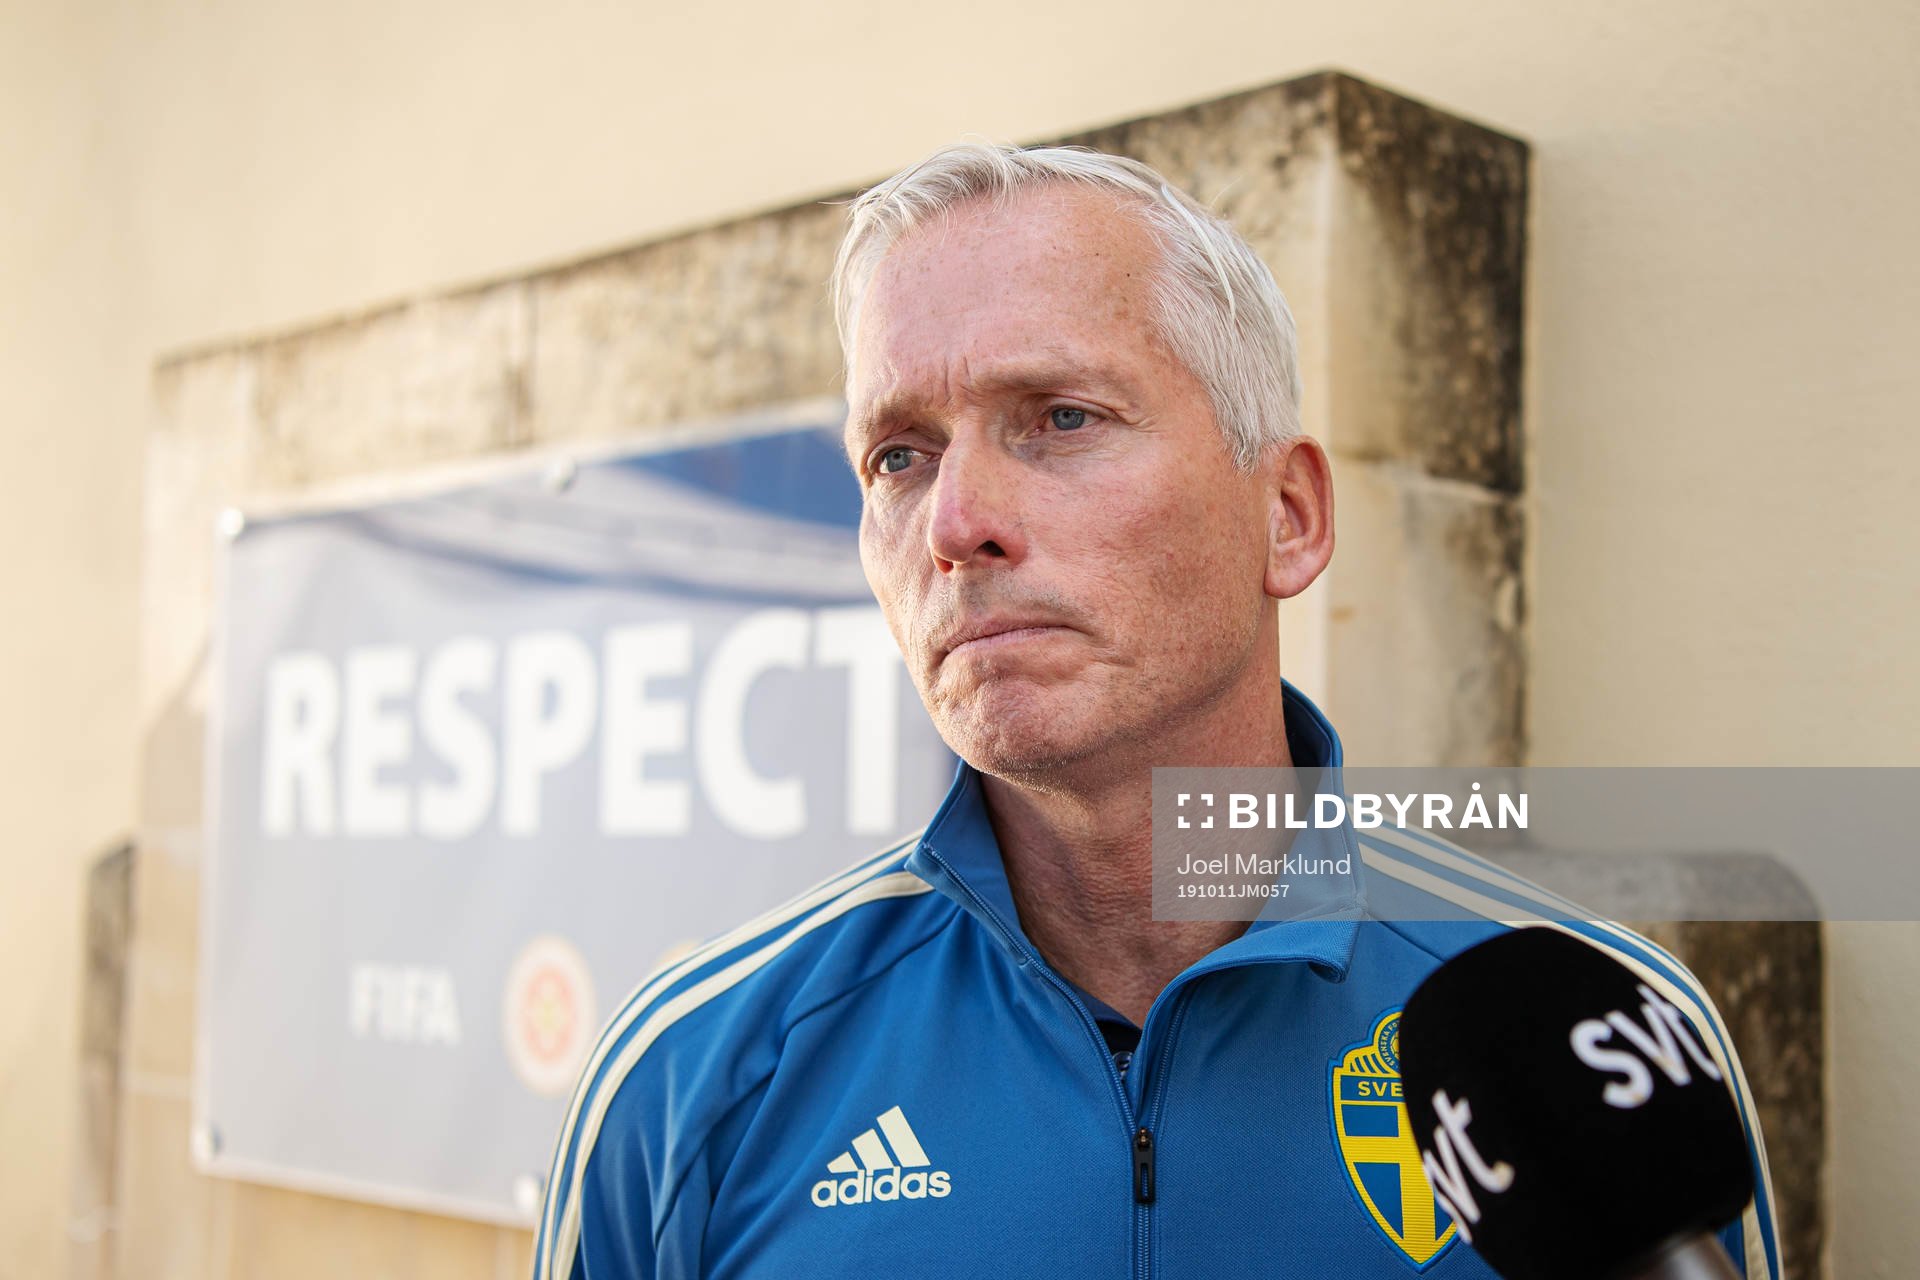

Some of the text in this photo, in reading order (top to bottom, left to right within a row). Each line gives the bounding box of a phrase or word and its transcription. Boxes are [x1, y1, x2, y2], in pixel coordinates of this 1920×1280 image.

[260, 608, 904, 839] RESPECT
[350, 962, 461, 1045] FIFA
[1570, 984, 1722, 1109] svt
[1358, 1081, 1404, 1097] SVE
[811, 1166, 952, 1208] adidas
